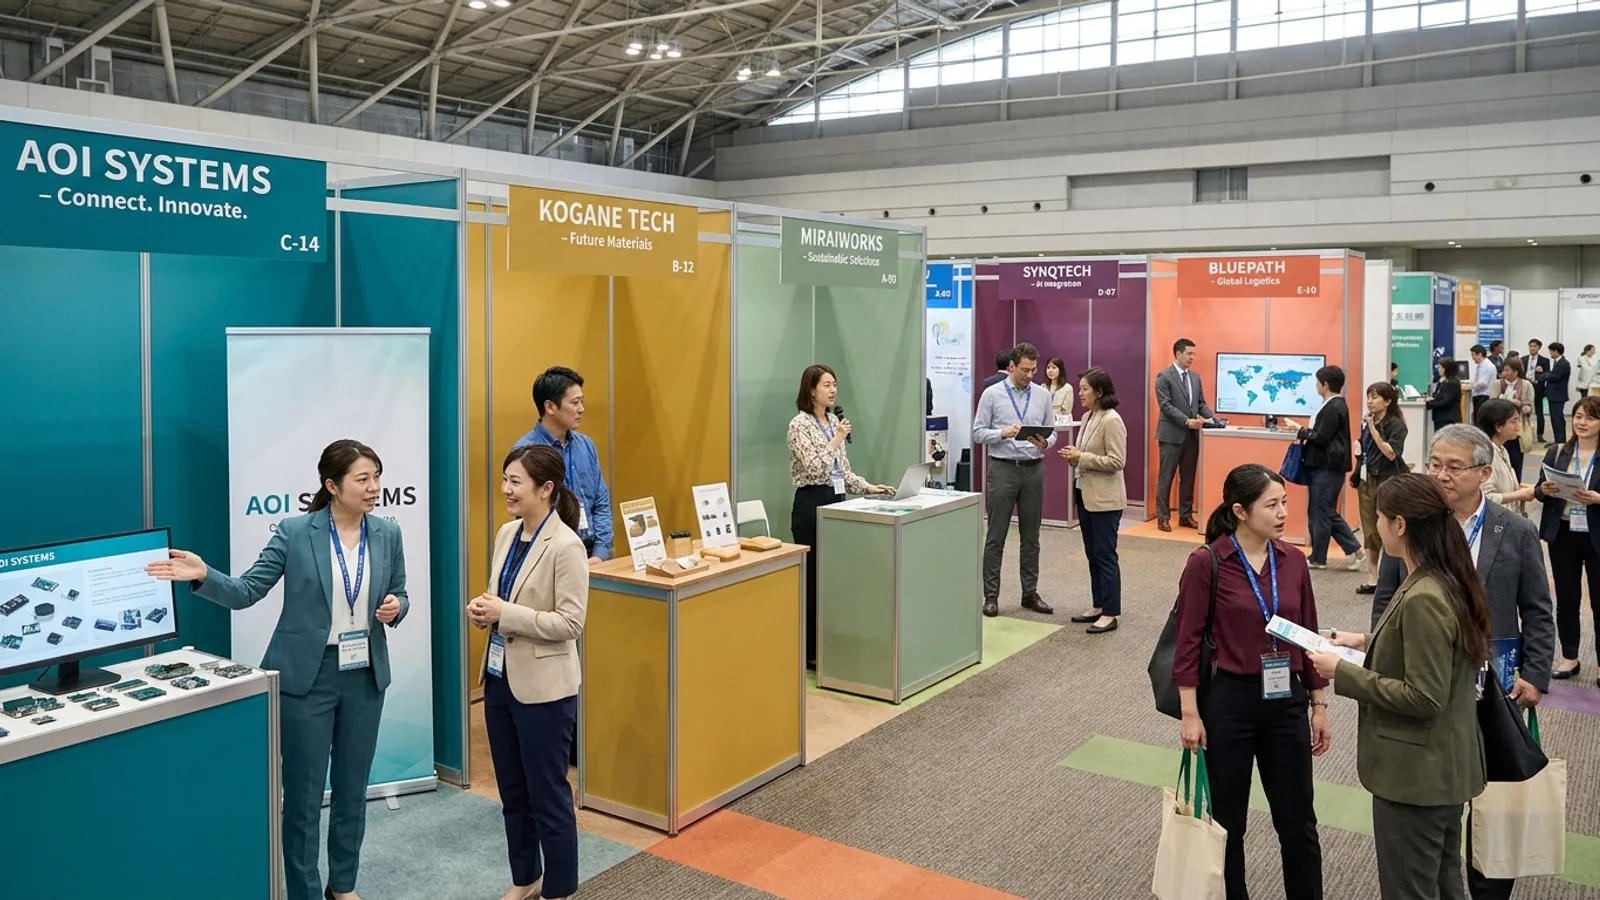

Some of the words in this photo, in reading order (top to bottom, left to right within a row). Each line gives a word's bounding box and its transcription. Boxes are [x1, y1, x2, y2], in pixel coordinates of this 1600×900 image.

[16, 140, 91, 178] AOI
[104, 148, 271, 196] SYSTEMS
[58, 186, 153, 213] Connect.
[160, 195, 248, 220] Innovate.
[539, 198, 623, 229] KOGANE
[628, 207, 675, 234] TECH
[280, 235, 320, 253] C-14
[570, 231, 605, 248] Future
[607, 236, 653, 251] Materials
[800, 227, 883, 252] MIRAIWORKS
[672, 259, 695, 274] B-12
[1023, 264, 1092, 280] SYNQTECH
[1209, 260, 1286, 275] BLUEPATH
[245, 493, 291, 516] AOI
[10, 551, 56, 567] SYSTEMS
